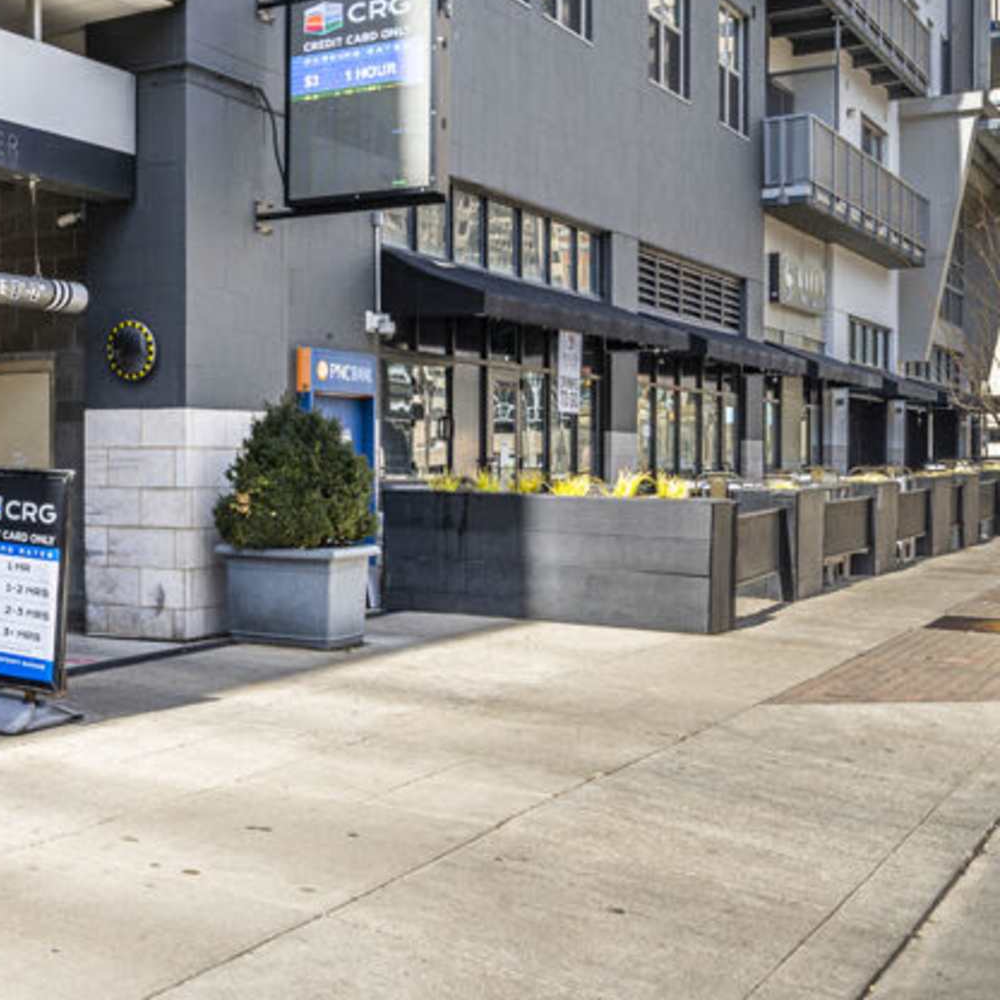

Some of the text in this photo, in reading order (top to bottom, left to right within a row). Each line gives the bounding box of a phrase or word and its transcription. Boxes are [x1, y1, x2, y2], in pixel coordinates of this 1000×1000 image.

[304, 38, 342, 52] CREDIT
[346, 32, 378, 45] CARD
[356, 62, 397, 79] HOUR
[4, 500, 58, 524] CRG
[1, 528, 29, 543] CARD
[29, 532, 57, 546] ONLY
[15, 563, 31, 573] HR
[5, 583, 23, 594] 1-2
[25, 586, 49, 599] HRS
[4, 605, 23, 617] 2-3
[25, 609, 49, 622] HRS
[17, 630, 41, 643] HRS
